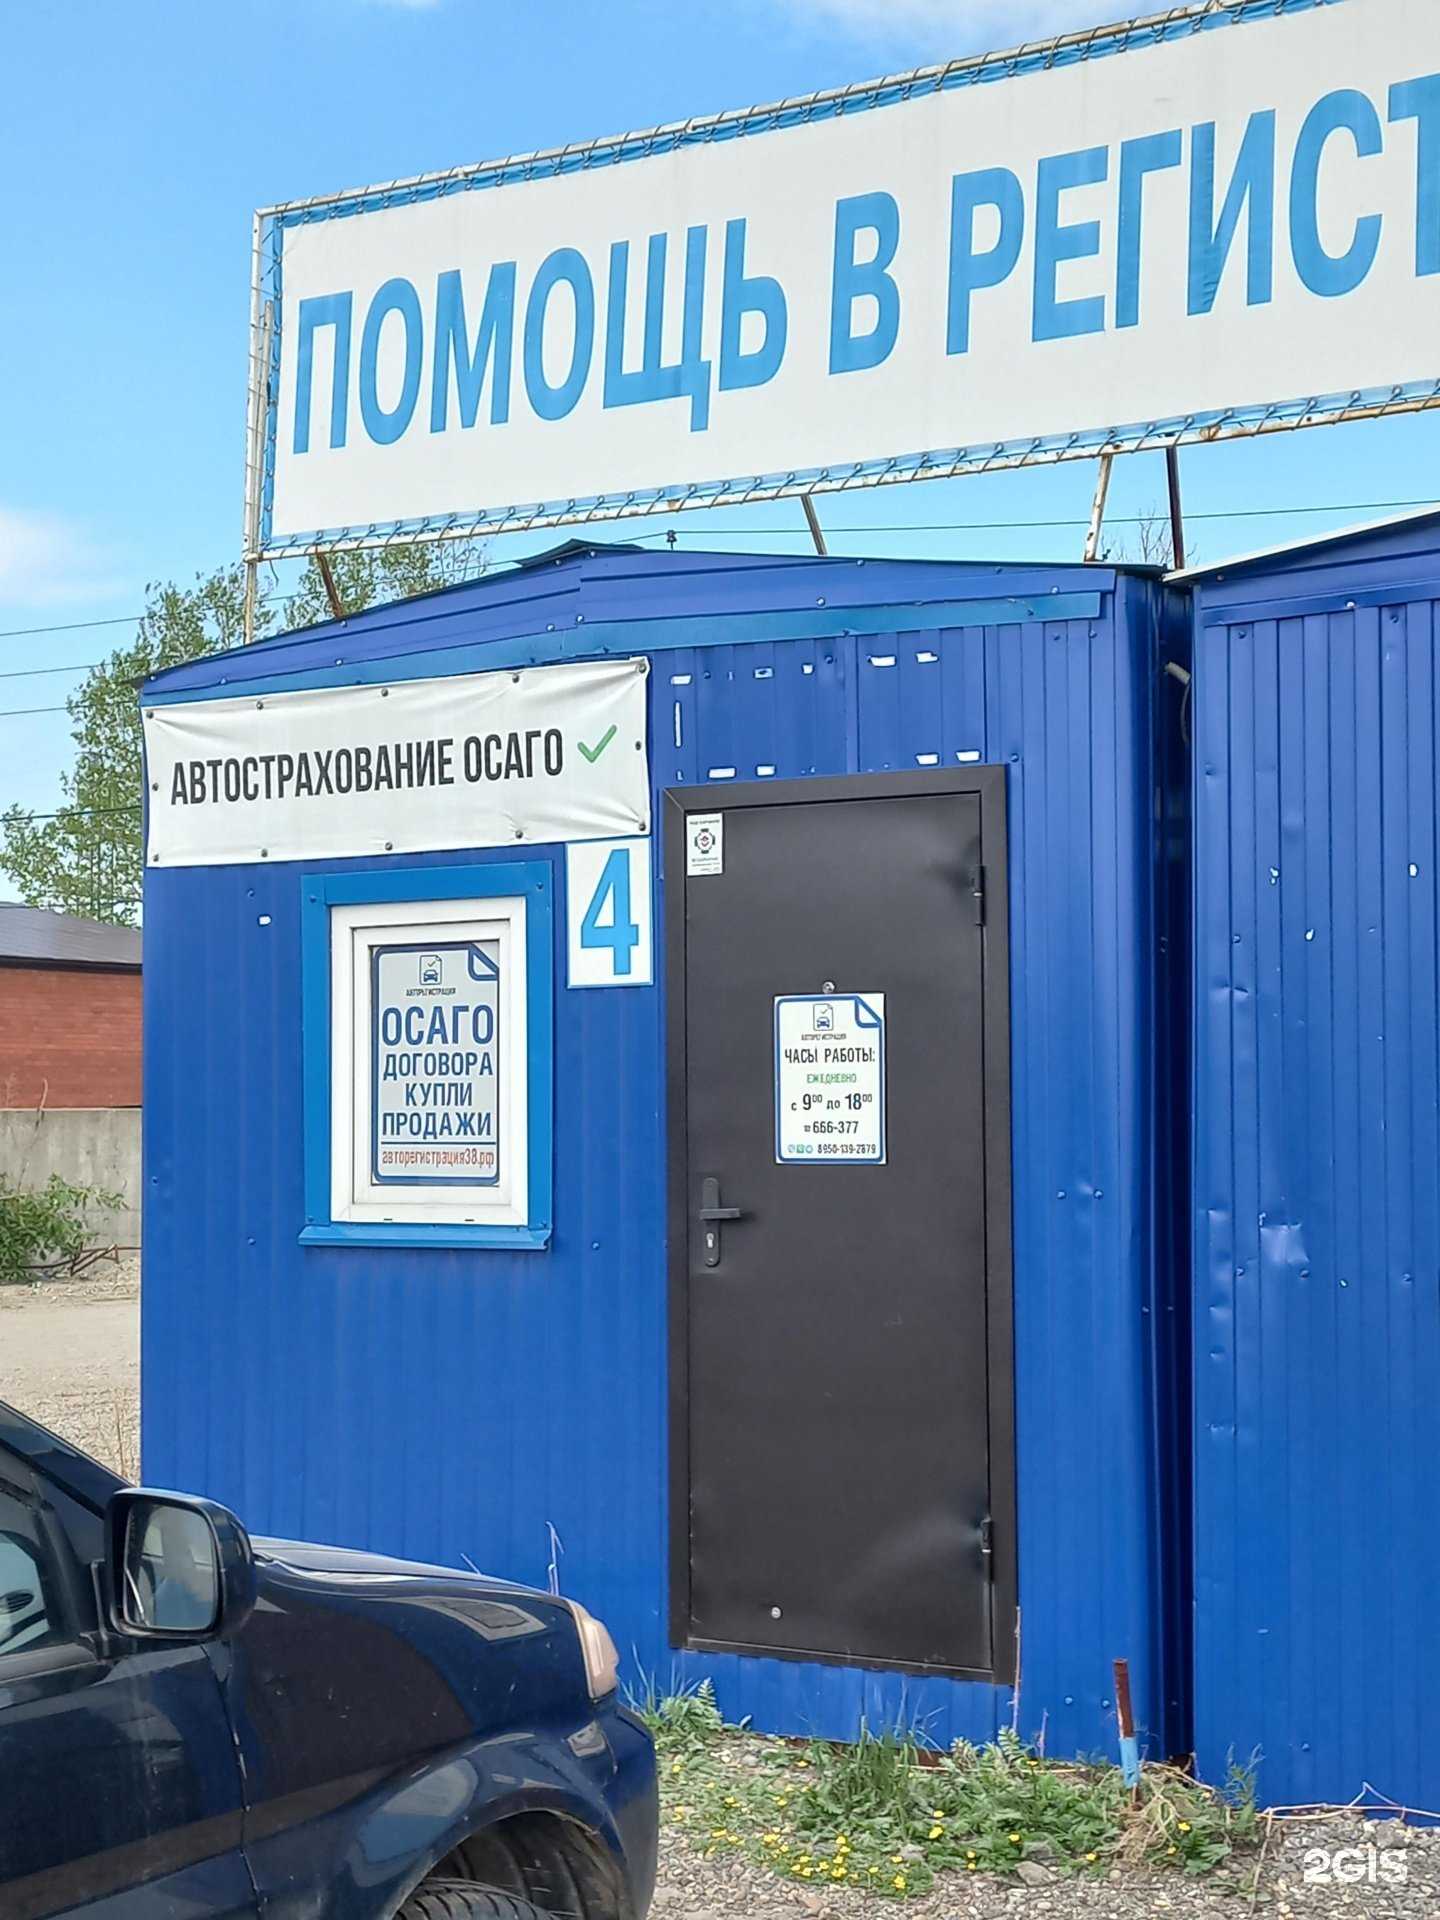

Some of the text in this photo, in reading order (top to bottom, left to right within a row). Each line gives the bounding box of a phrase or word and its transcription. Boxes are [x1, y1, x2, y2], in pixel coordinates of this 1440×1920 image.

[293, 73, 1440, 455] ПОМОЩЬ В РЕГИСТ
[171, 728, 564, 805] АВТОСТРАХОВАНИЕ ОСАГО
[580, 848, 640, 976] 4
[382, 1005, 493, 1046] ОСАГО
[383, 1052, 493, 1081] ДОГОВОРА
[784, 1047, 875, 1063] ЧАСЫ РАБОТЫ:
[806, 1073, 857, 1085] ЕЖЕДНЕВНО
[405, 1082, 472, 1107] КУПЛИ
[826, 1099, 841, 1110] до
[382, 1112, 491, 1140] ПРОДАЖИ
[813, 1120, 859, 1134] 666-377
[382, 1148, 494, 1168] авторегистрация38.рф
